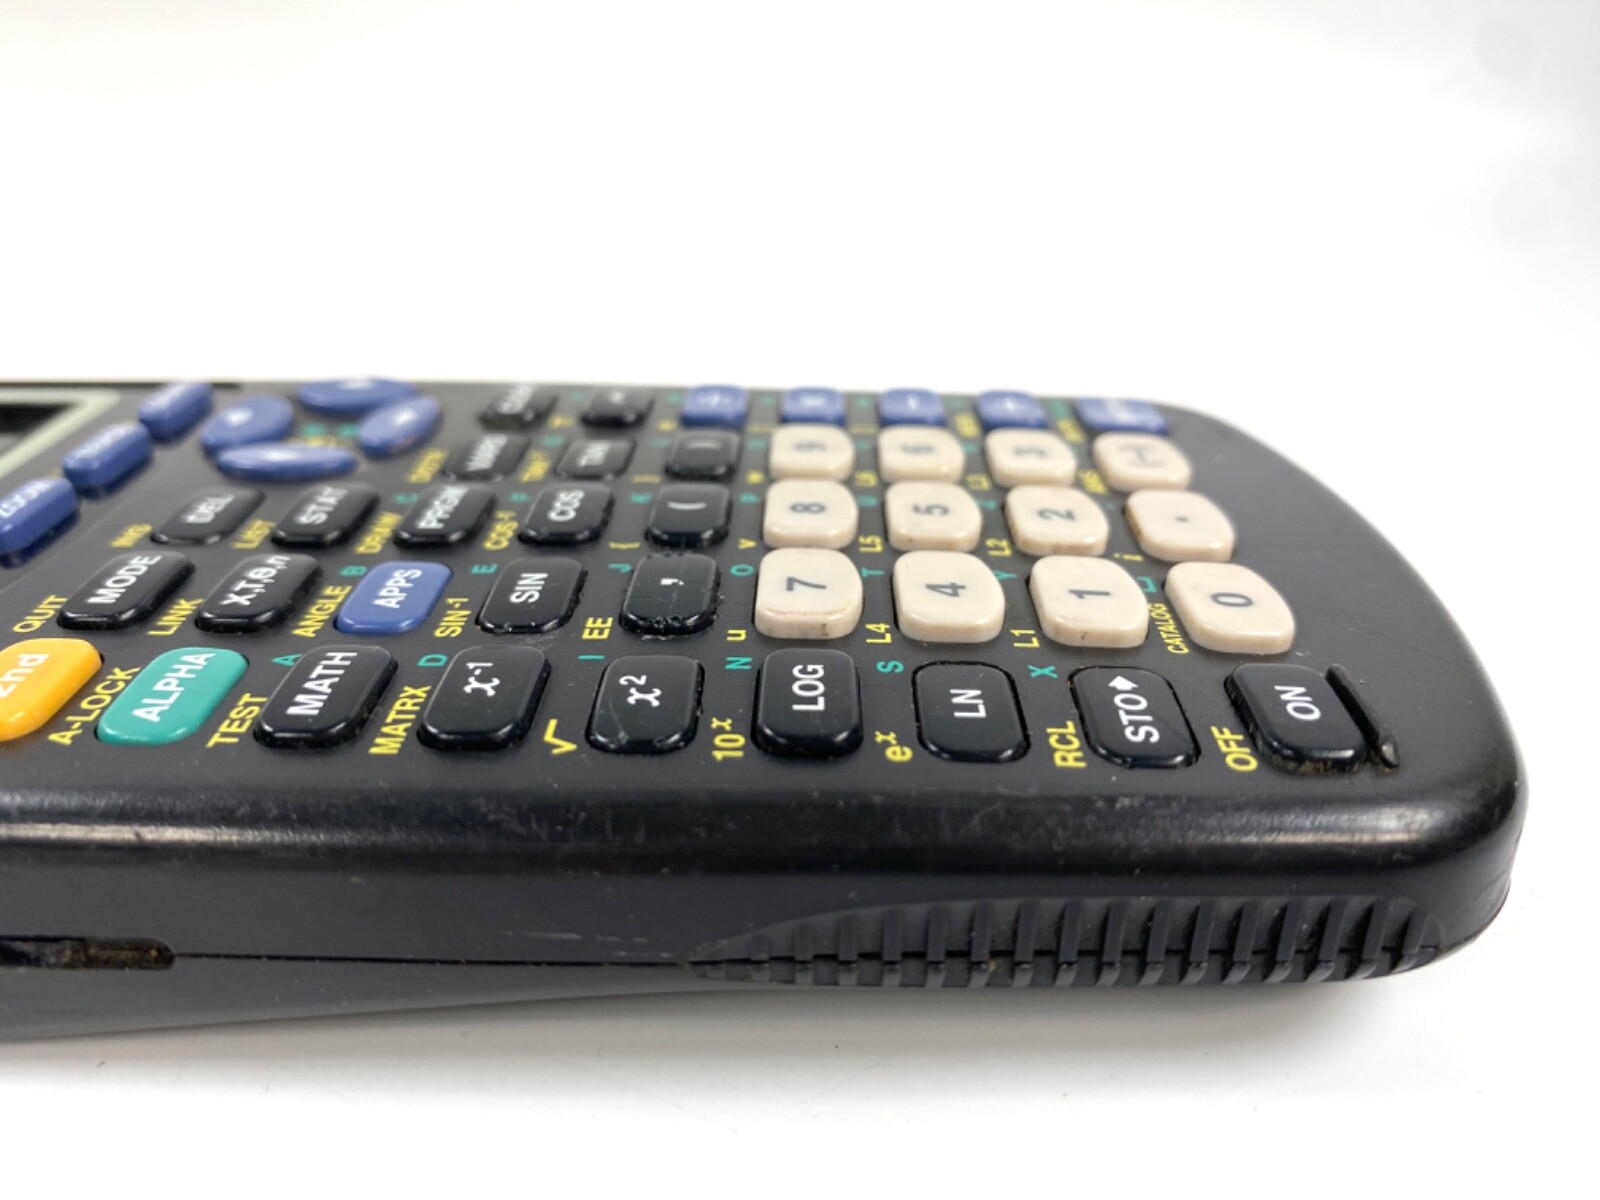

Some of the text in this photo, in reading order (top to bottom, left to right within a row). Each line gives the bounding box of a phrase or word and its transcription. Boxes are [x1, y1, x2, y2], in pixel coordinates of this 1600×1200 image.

[297, 487, 347, 525] STAT
[418, 486, 469, 529] PRGM
[548, 490, 585, 522] COS
[789, 503, 827, 514] 8
[913, 504, 951, 515] 5
[1036, 507, 1077, 522] 2
[859, 535, 883, 553] L5
[986, 538, 1013, 557] L2
[86, 555, 163, 604] MODE
[471, 564, 497, 574] E
[609, 564, 632, 574] J
[785, 576, 827, 592] 7
[373, 569, 422, 609] APPS
[509, 572, 549, 604] SIN
[925, 581, 967, 597] 4
[1068, 588, 1112, 599] 1
[14, 595, 67, 633] QUIT
[148, 598, 204, 635] LINK
[292, 585, 352, 638] ANGLE
[582, 616, 614, 640] EE
[866, 622, 893, 644] L4
[1014, 629, 1040, 649] L1
[1149, 603, 1190, 655] CATALOG
[273, 654, 301, 667] A
[417, 653, 448, 667] D
[724, 656, 752, 671] N
[876, 660, 904, 674] S
[1028, 665, 1057, 679] X
[132, 652, 217, 723] ALPHA
[286, 651, 359, 717] MATH
[791, 663, 826, 712] LOG
[48, 667, 141, 746] A-LOCK
[949, 687, 987, 719] LN
[1274, 684, 1322, 722] ON
[207, 693, 268, 749] TEST
[368, 685, 431, 756] MATRX
[1046, 720, 1087, 769] RCL
[1210, 725, 1259, 773] OFF
